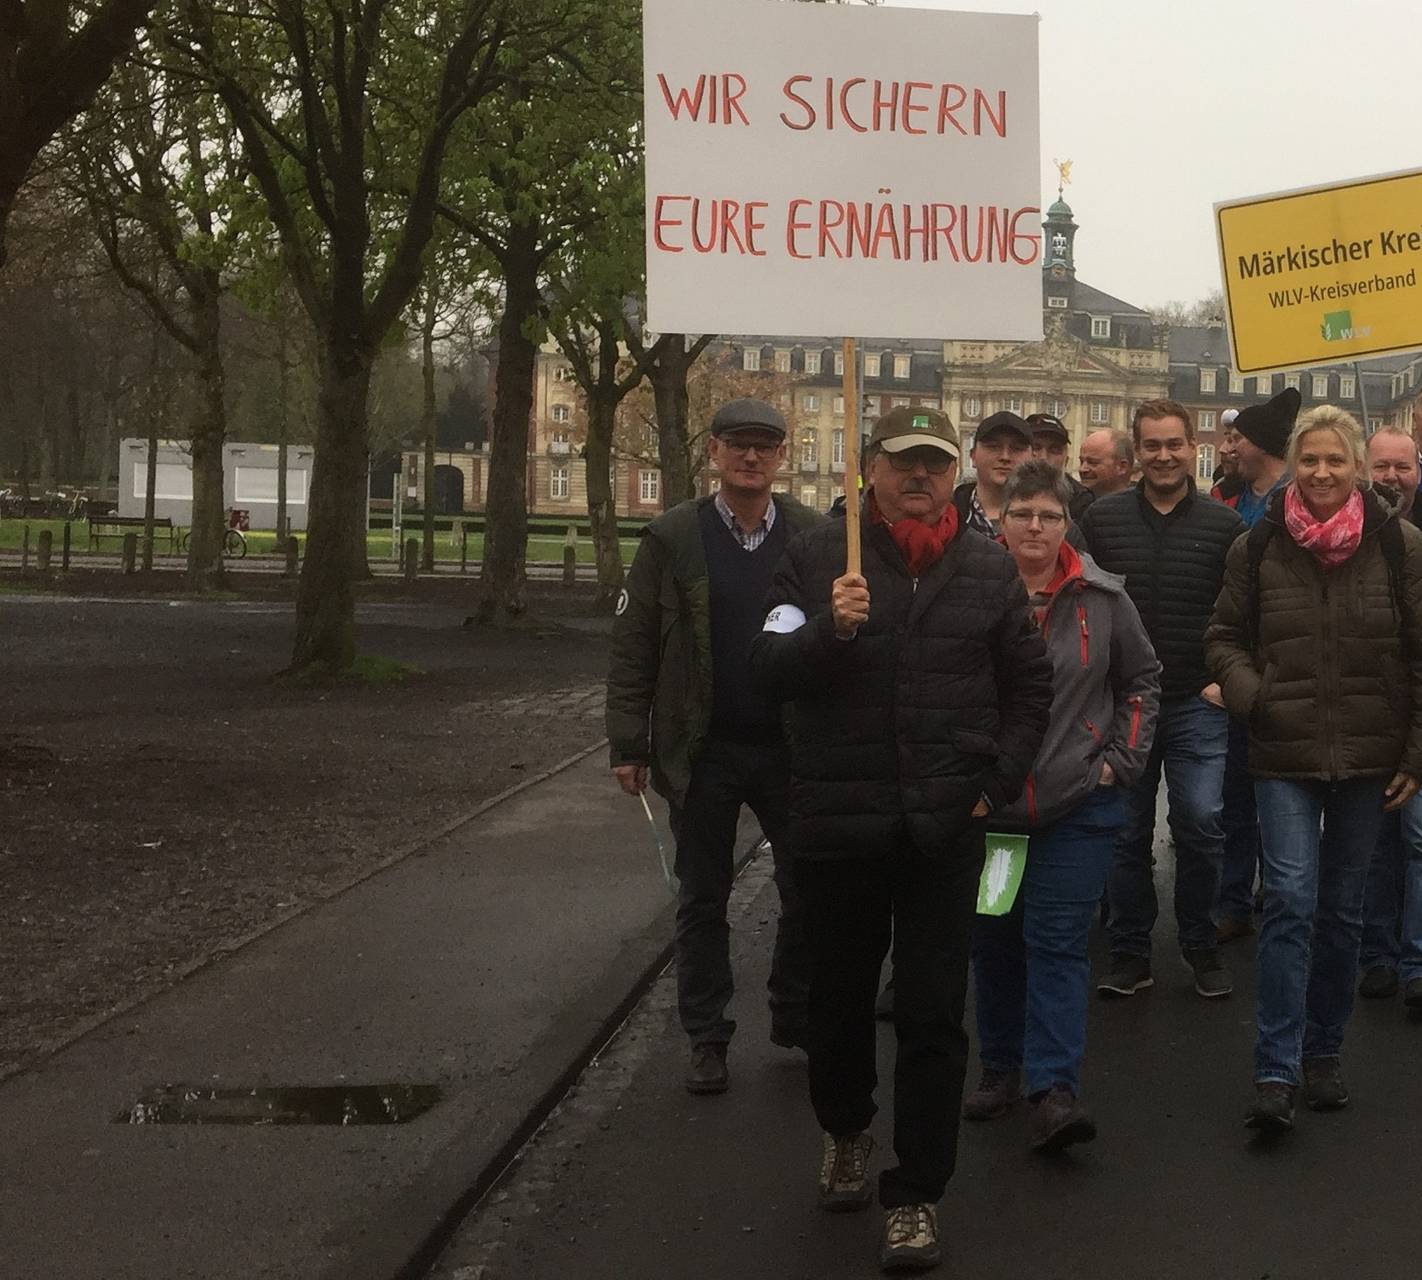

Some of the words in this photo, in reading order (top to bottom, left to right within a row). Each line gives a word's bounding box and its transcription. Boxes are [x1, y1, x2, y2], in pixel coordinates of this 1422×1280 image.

[657, 73, 750, 126] WIR
[779, 75, 1007, 138] SICHERN
[653, 195, 769, 257] EURE
[786, 188, 1042, 266] ERNÄHRUNG
[1238, 238, 1373, 280] Märkischer
[1268, 269, 1416, 309] WLV-Kreisverband
